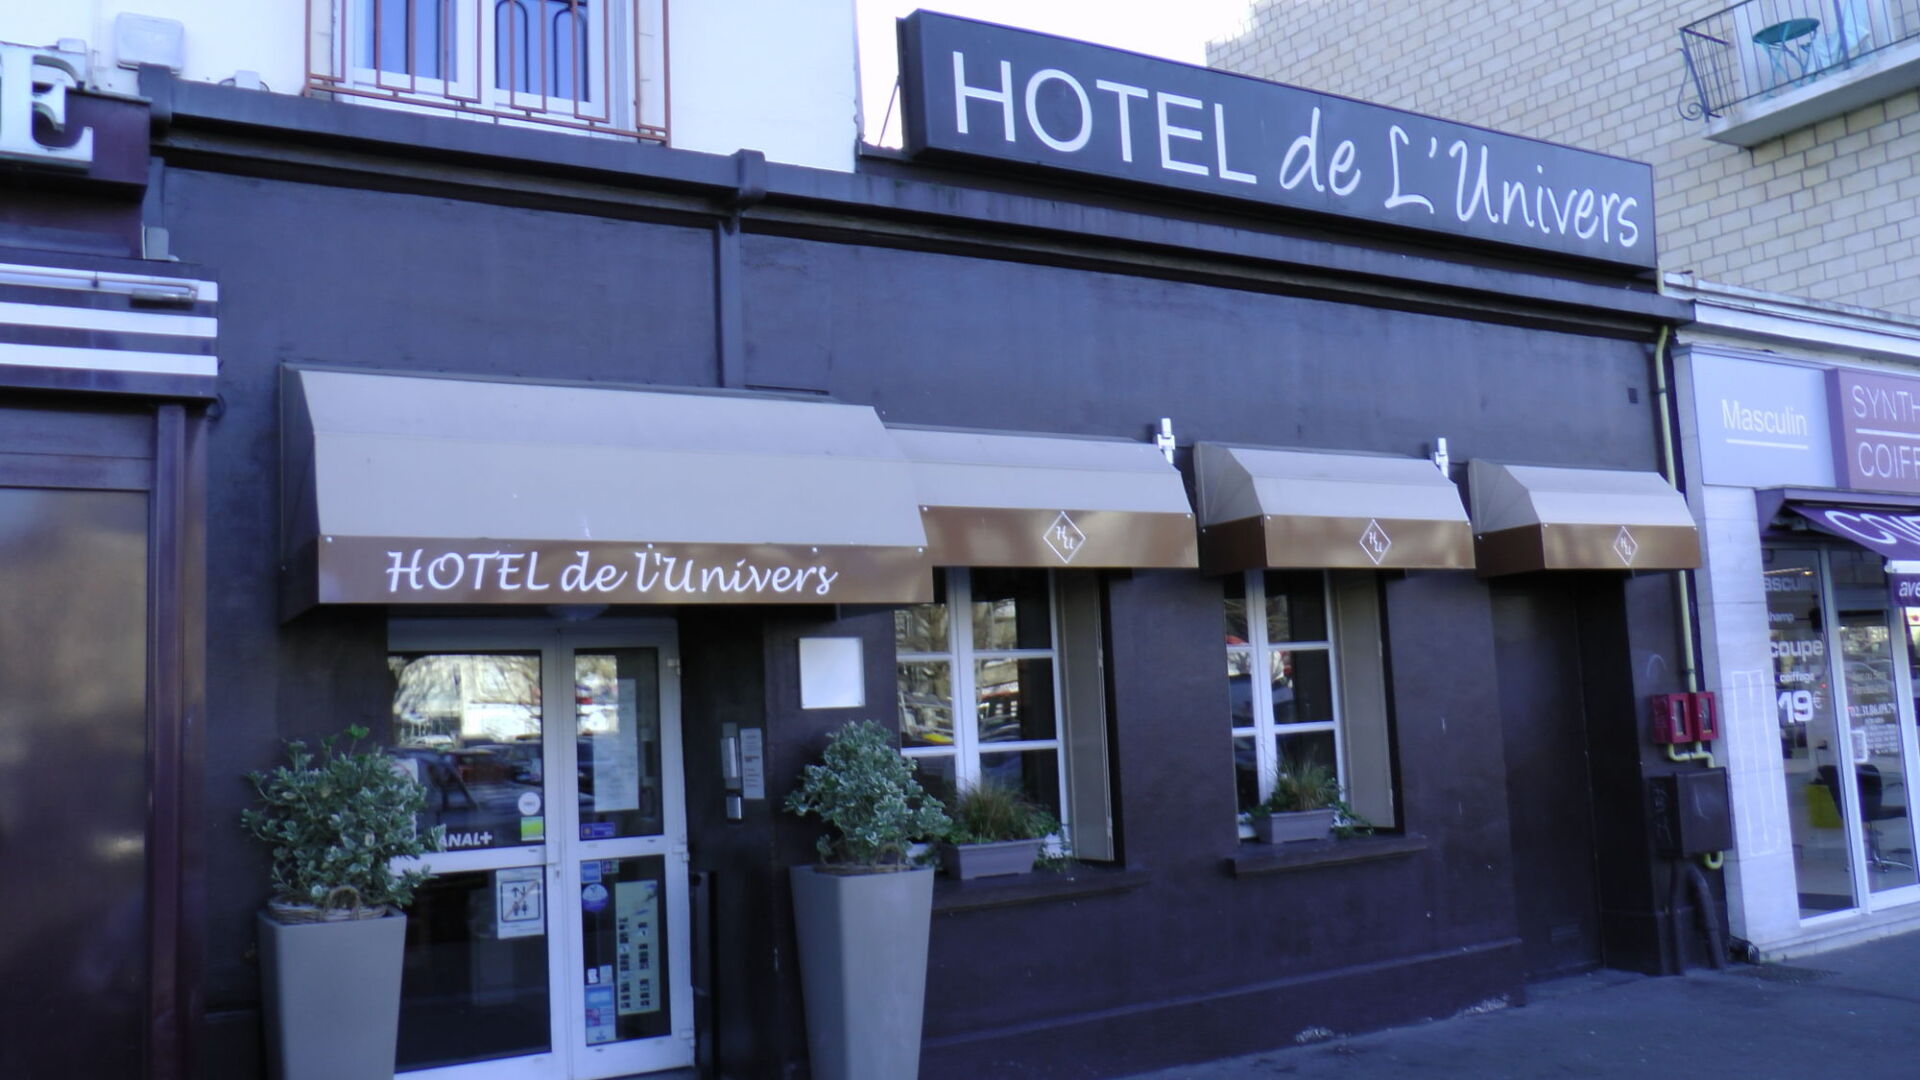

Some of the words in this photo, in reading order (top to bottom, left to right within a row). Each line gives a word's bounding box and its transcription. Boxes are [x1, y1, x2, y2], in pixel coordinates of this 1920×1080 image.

[953, 50, 1257, 185] HOTEL
[1279, 106, 1361, 196] de
[1384, 123, 1640, 248] L'Univers
[1721, 399, 1808, 436] Masculin
[385, 548, 550, 593] HOTEL
[560, 551, 628, 593] de
[1770, 639, 1824, 662] coupe
